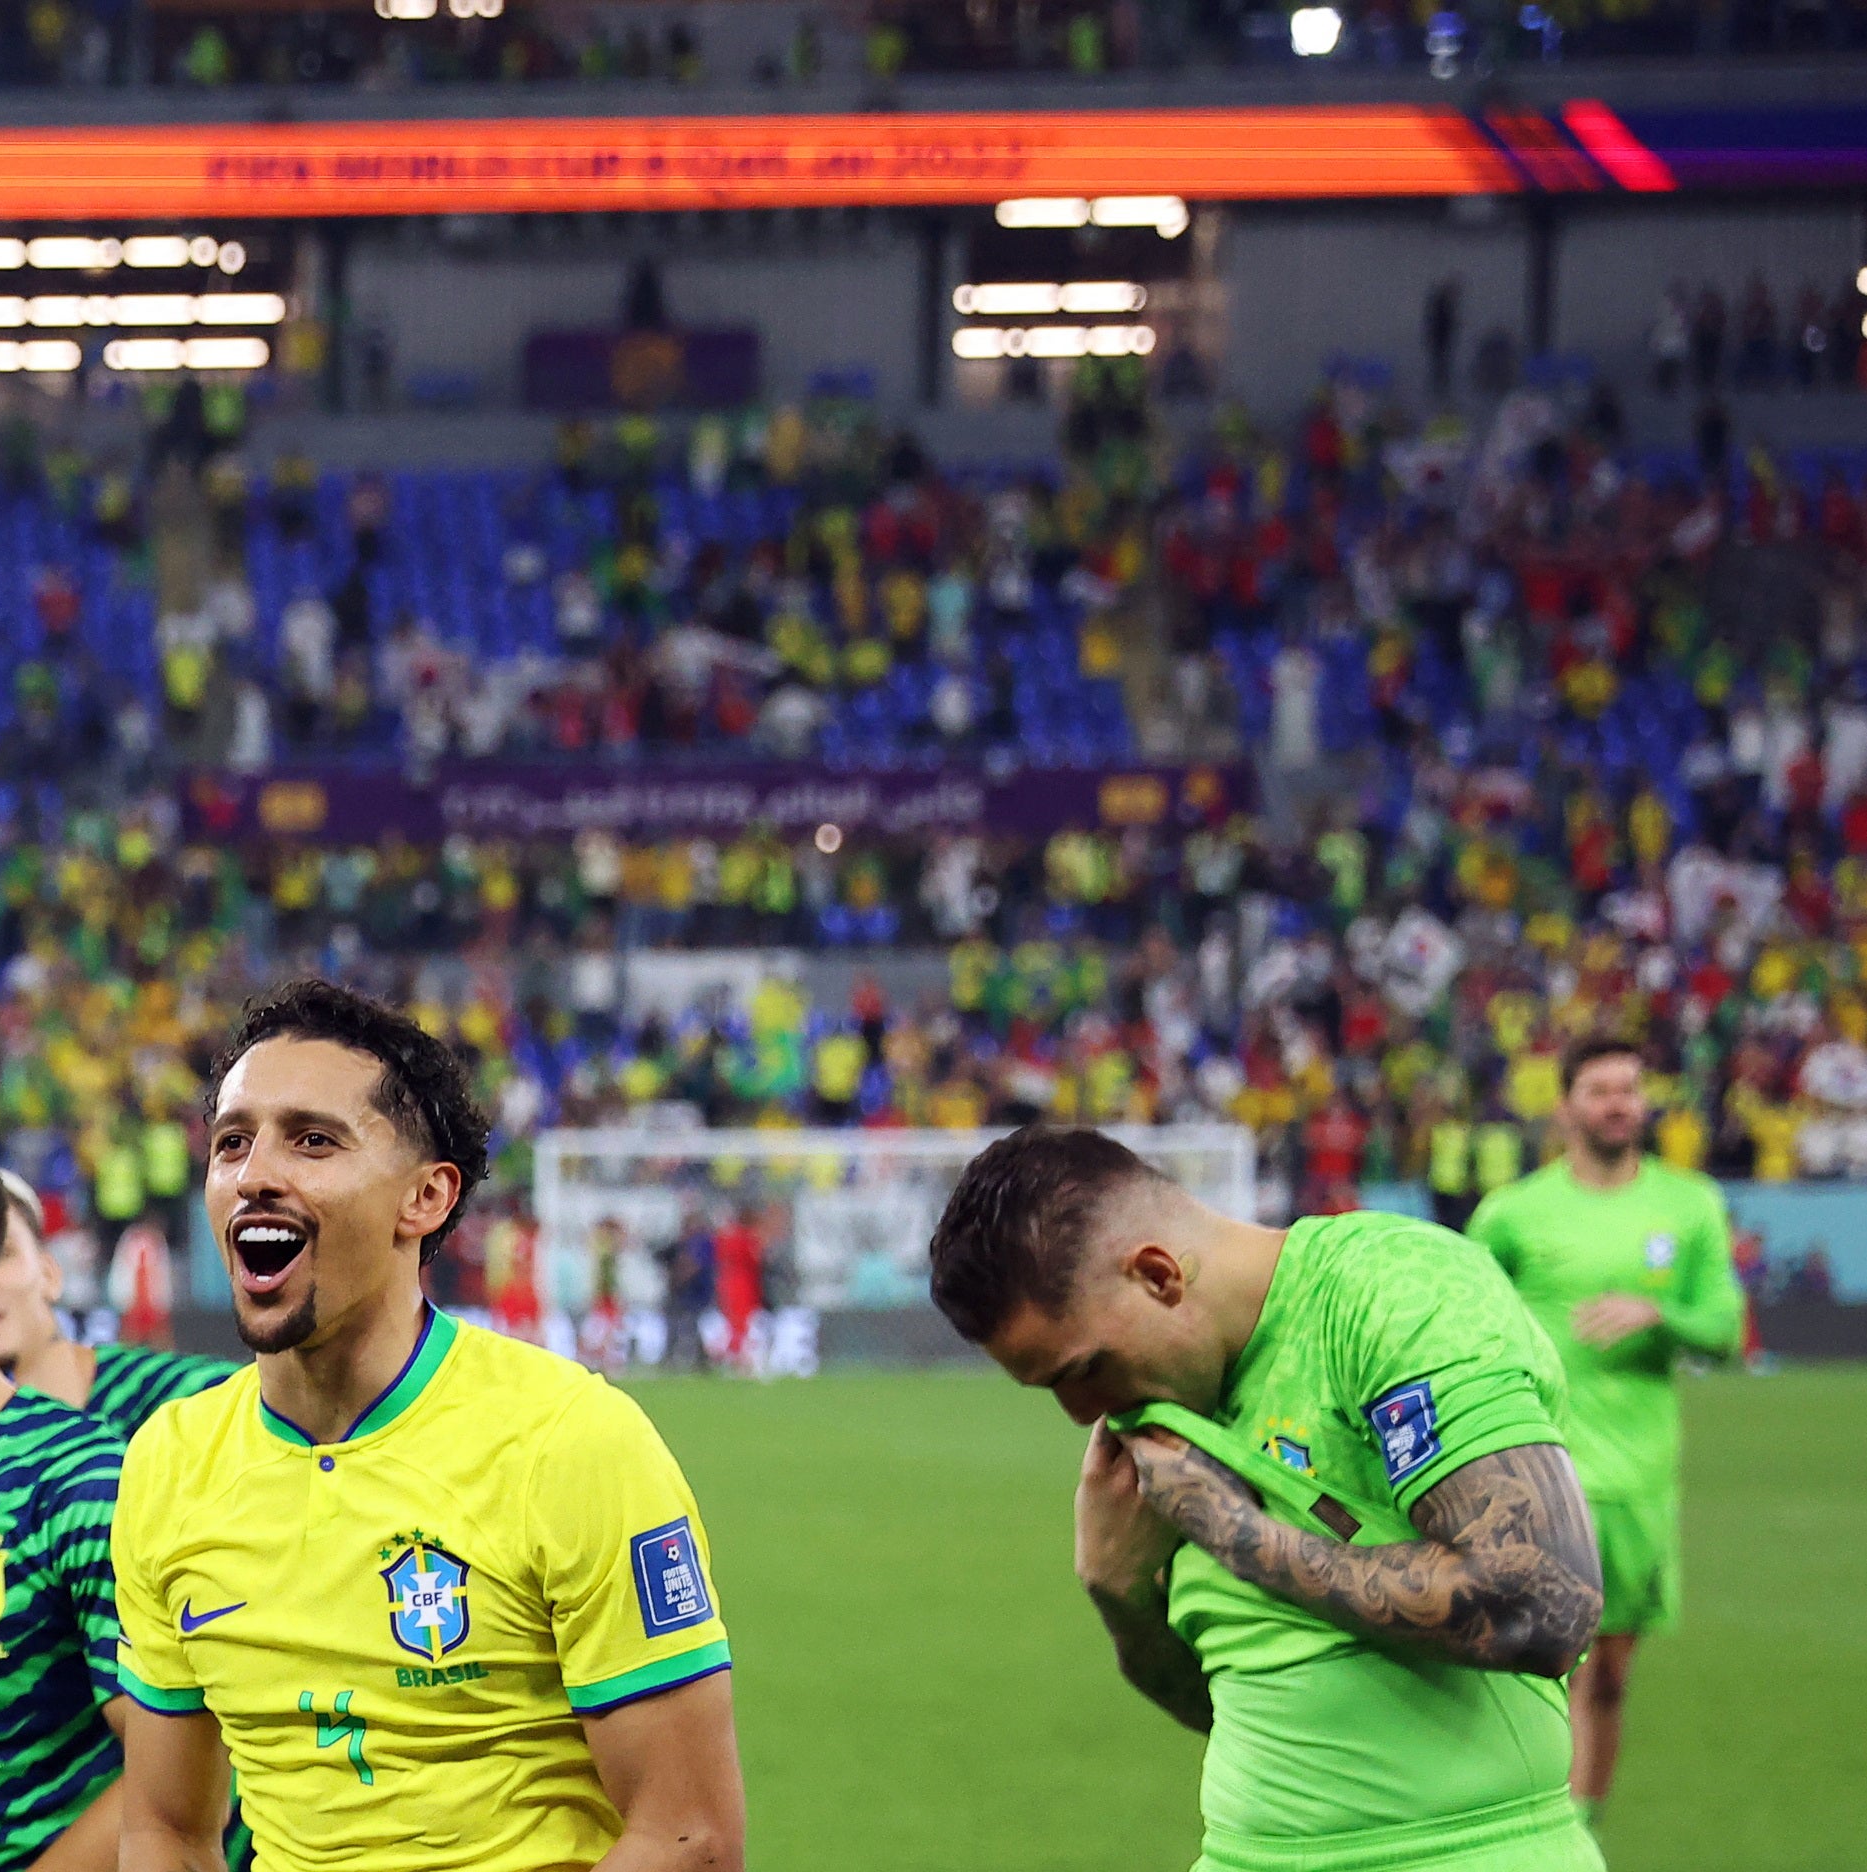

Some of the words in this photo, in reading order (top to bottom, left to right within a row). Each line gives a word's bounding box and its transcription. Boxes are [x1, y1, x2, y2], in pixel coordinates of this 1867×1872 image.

[412, 1592, 443, 1607] CBF
[395, 1661, 490, 1688] BRASIL
[298, 1689, 374, 1787] 4
